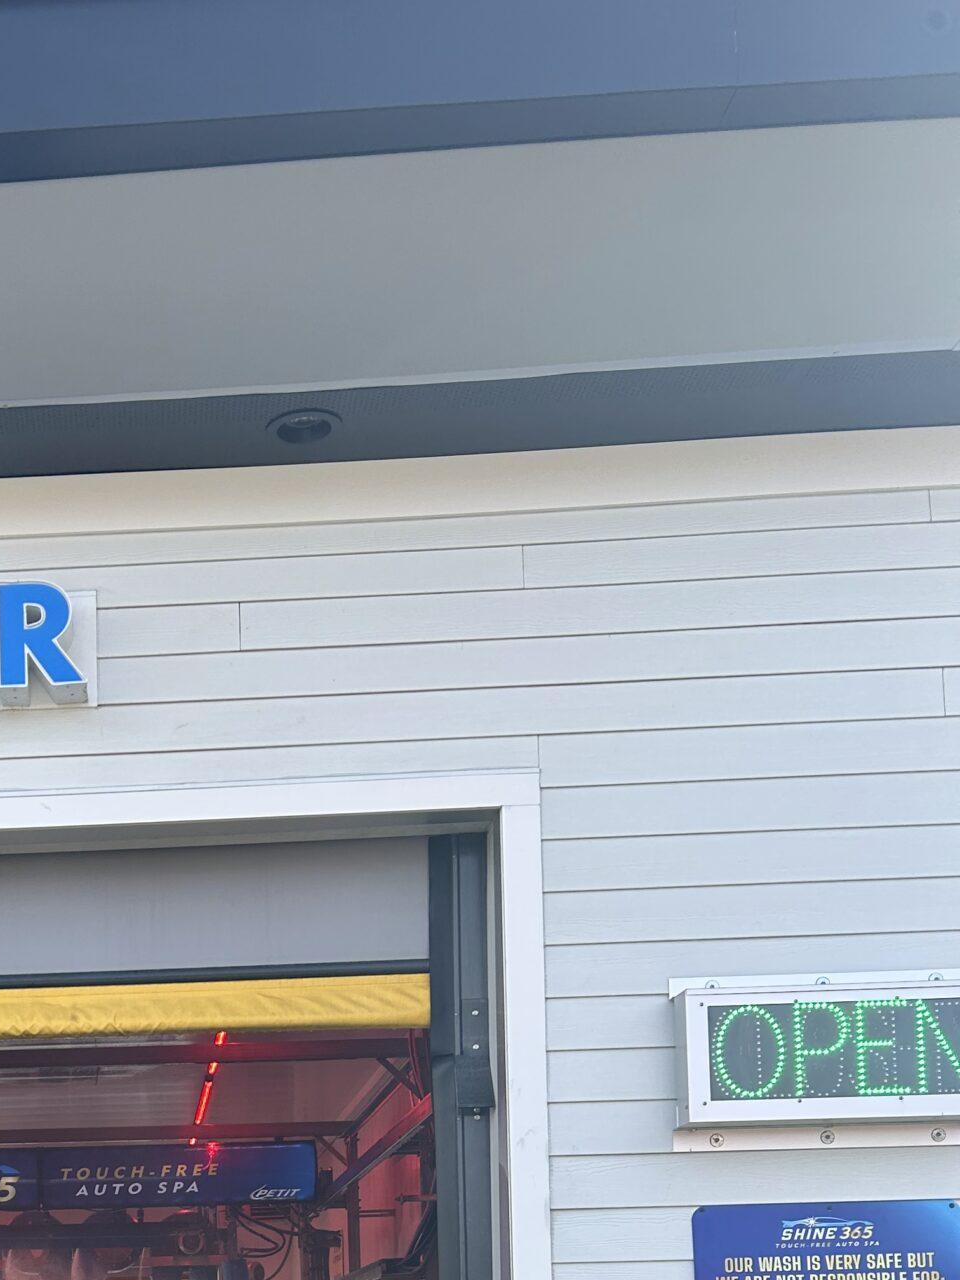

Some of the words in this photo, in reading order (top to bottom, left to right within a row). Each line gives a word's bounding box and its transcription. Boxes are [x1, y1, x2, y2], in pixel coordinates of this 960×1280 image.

[712, 998, 960, 1098] OPEN
[60, 1162, 220, 1181] TOUCH-FREE
[76, 1182, 143, 1197] AUTO
[157, 1180, 199, 1195] SPA
[251, 1187, 301, 1199] PETIT
[781, 1227, 838, 1240] SHINE
[839, 1225, 874, 1240] 365
[724, 1257, 753, 1273] OUR
[758, 1255, 801, 1272] WASH
[806, 1255, 821, 1270] IS
[825, 1253, 861, 1270] VERY
[866, 1252, 903, 1269] SAFE
[907, 1251, 935, 1268] BUT
